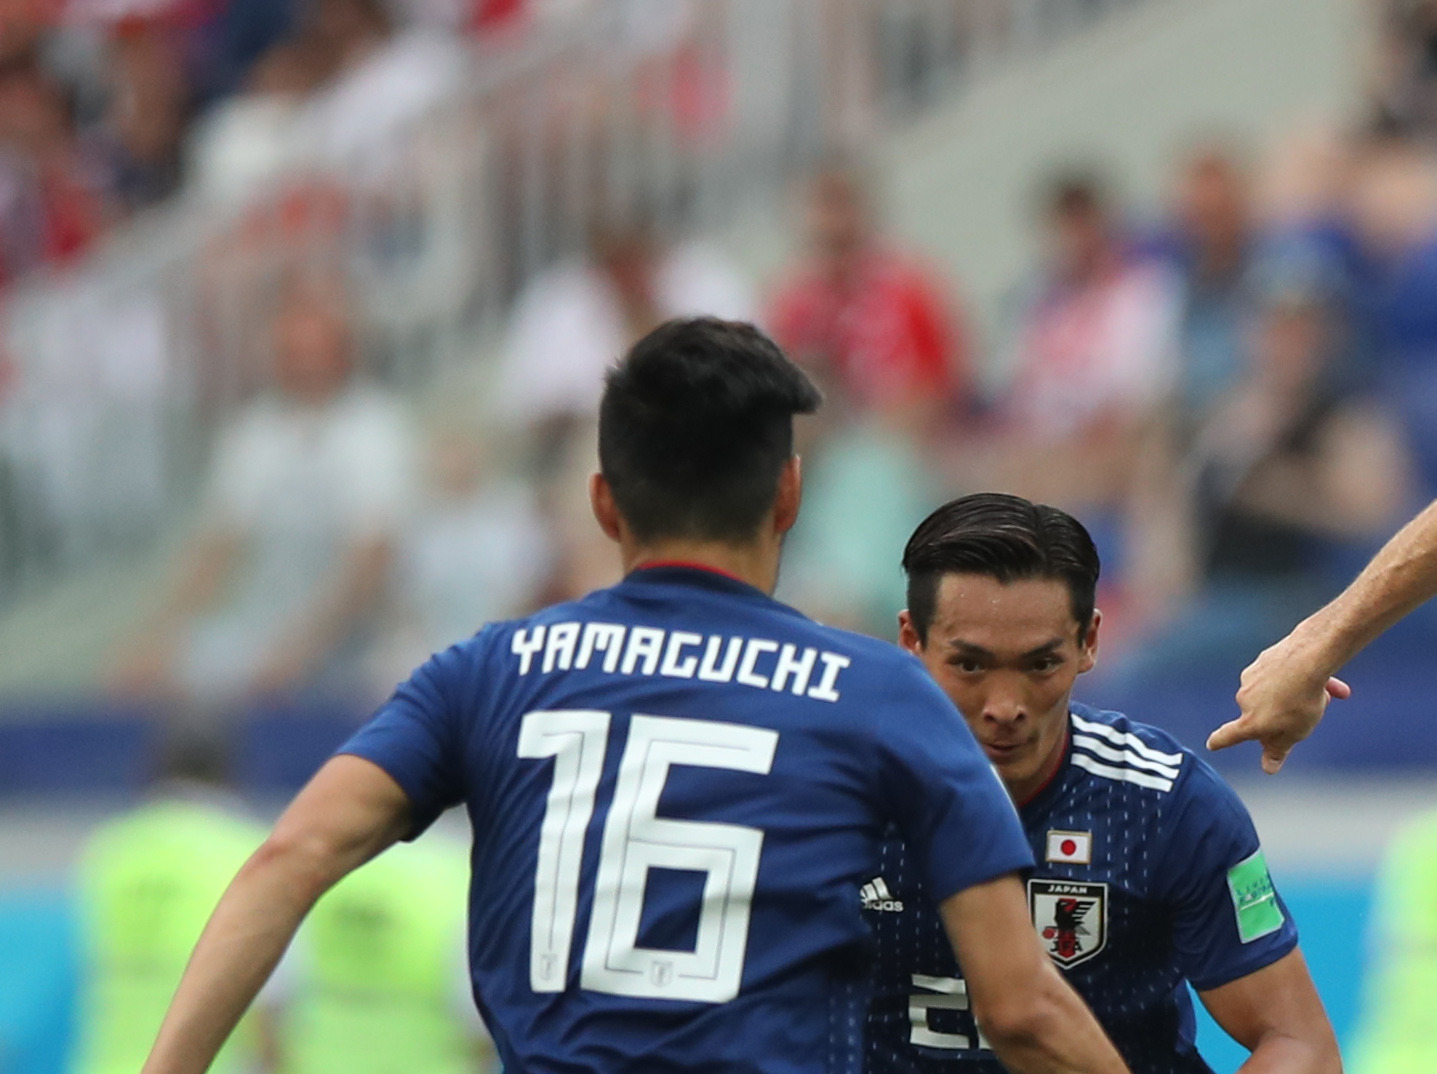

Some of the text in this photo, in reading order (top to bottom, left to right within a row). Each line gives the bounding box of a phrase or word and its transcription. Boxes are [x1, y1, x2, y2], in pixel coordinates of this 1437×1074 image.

[511, 622, 851, 703] YAMAGUCHI
[516, 709, 780, 1004] 16
[1047, 884, 1088, 895] JAPAN
[908, 973, 992, 1050] 2
